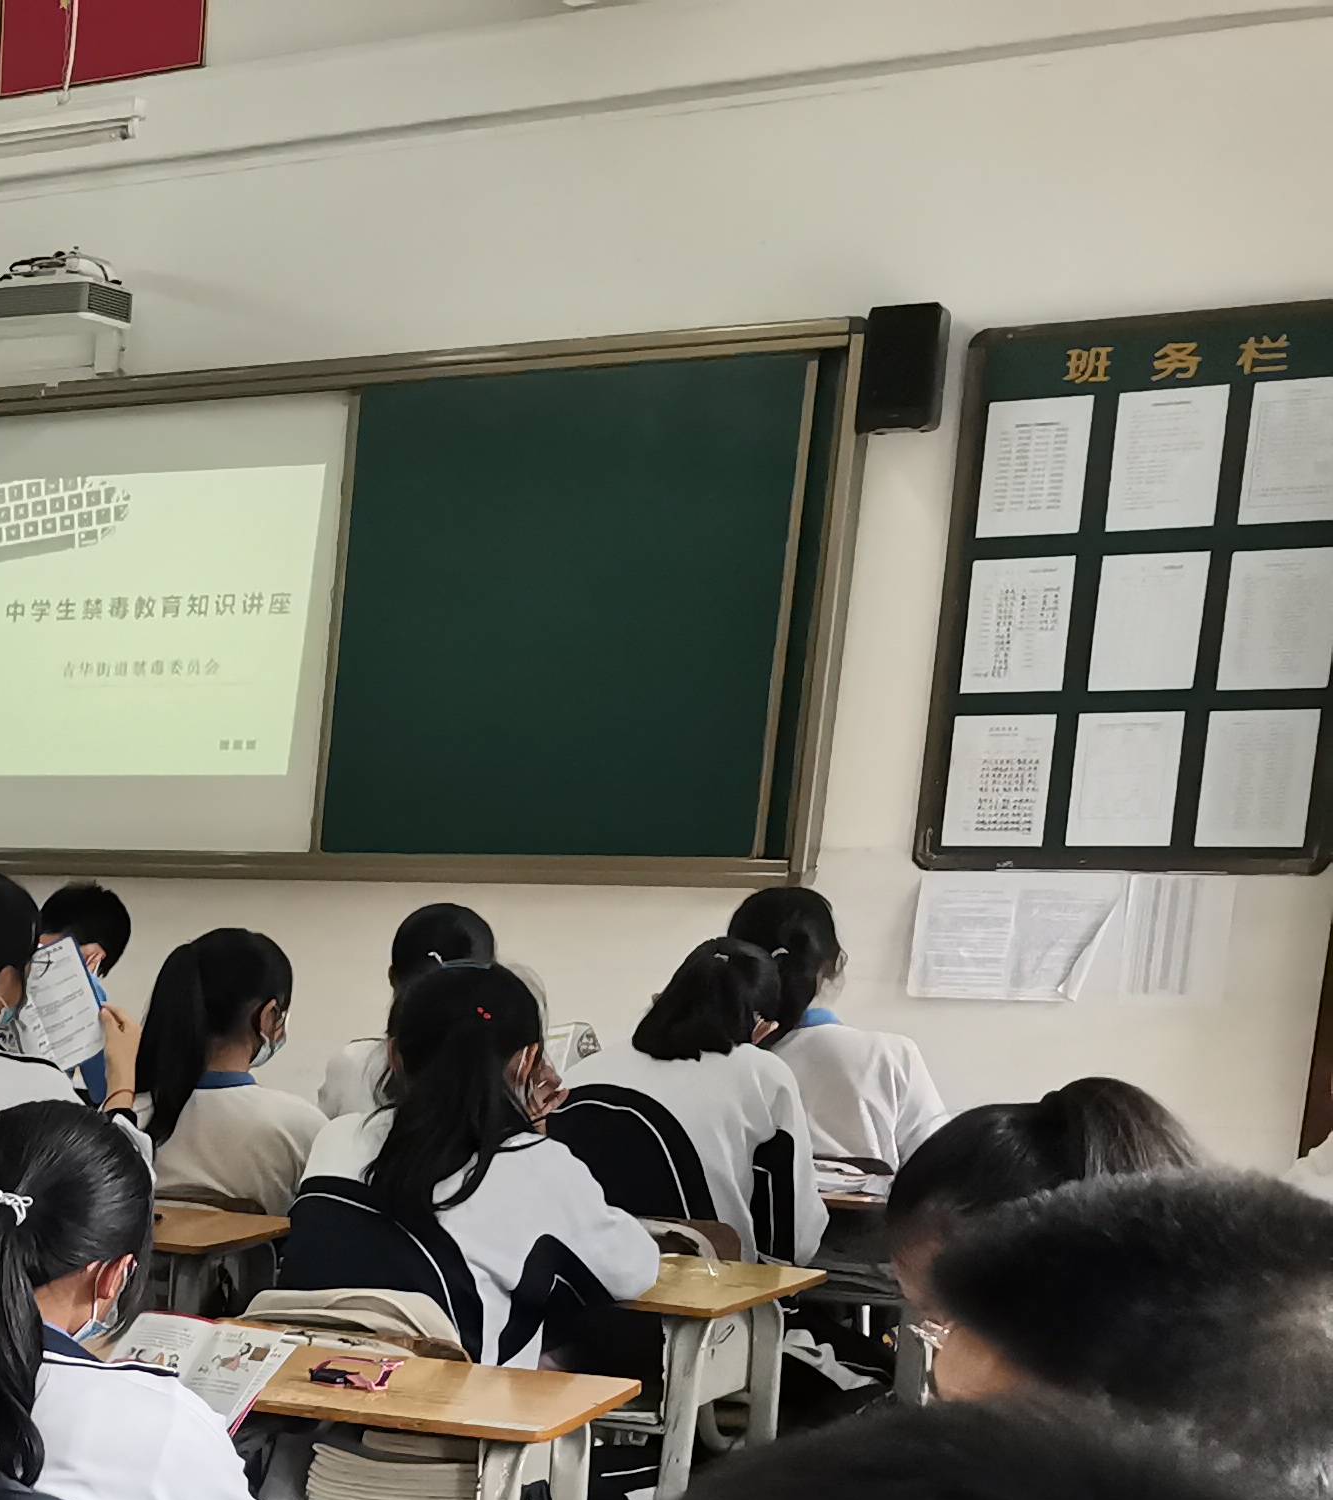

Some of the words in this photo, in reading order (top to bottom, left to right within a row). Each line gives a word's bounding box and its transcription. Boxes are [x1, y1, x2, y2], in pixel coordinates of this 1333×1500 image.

[1062, 334, 1290, 384] 班务栏
[6, 592, 292, 622] 中学生禁毒教育知识讲座
